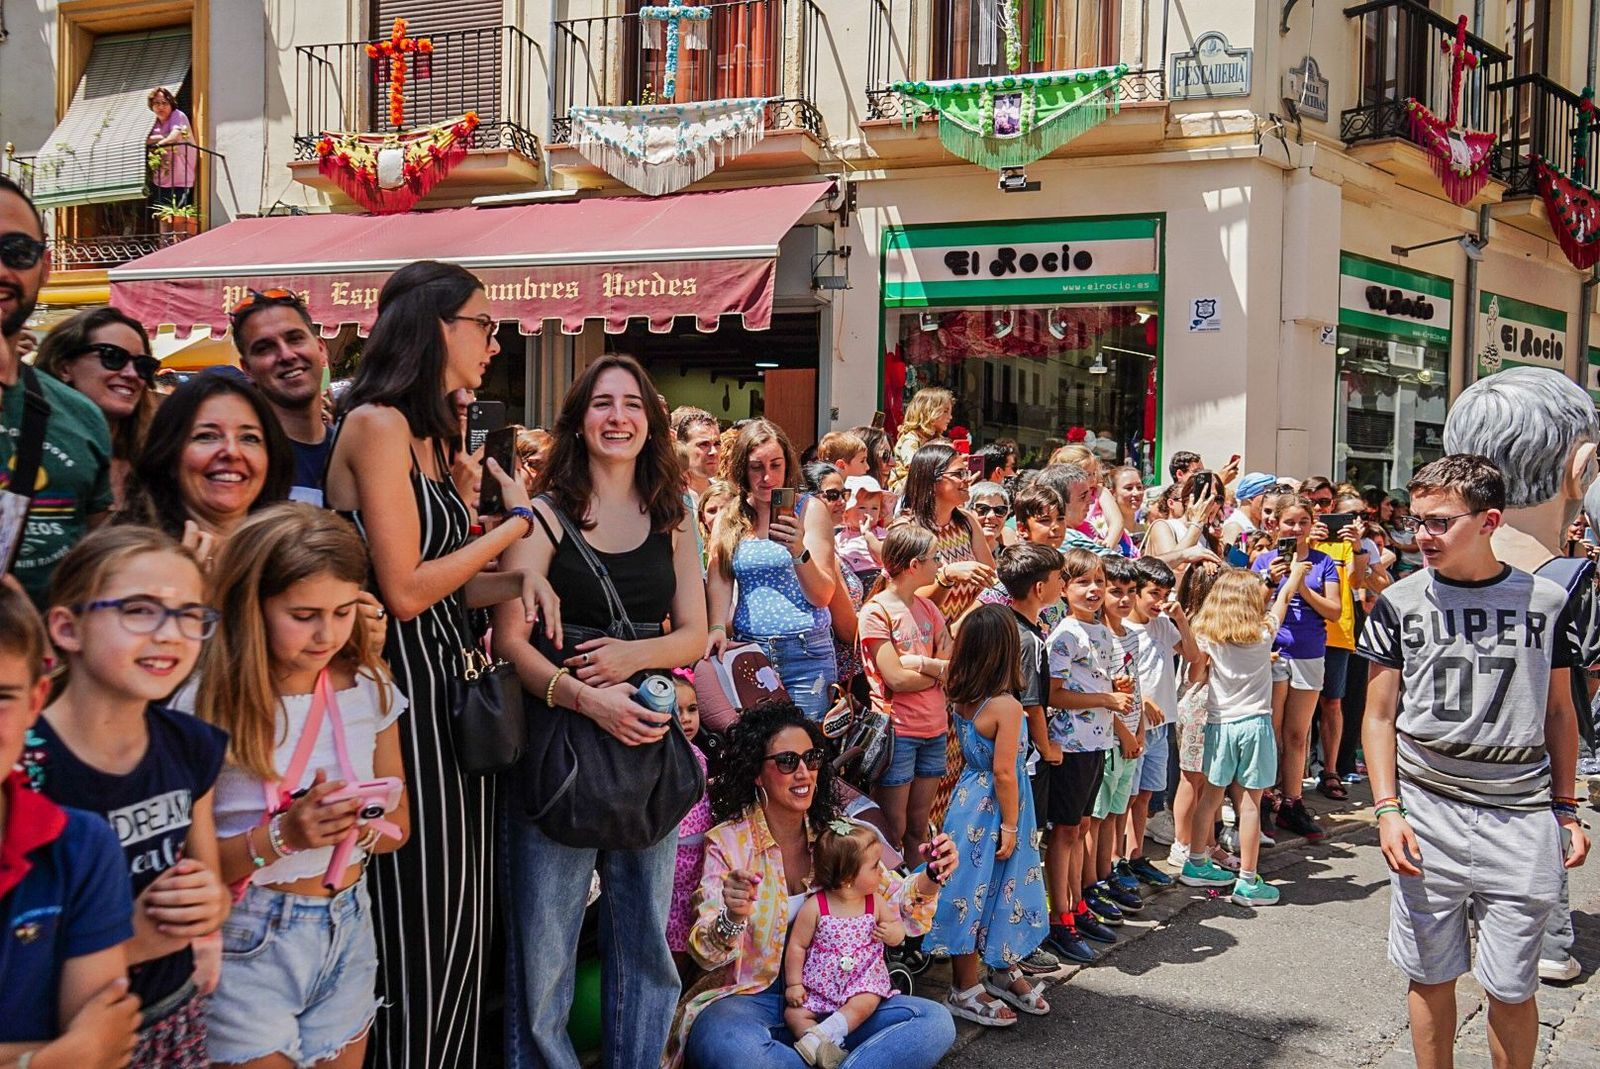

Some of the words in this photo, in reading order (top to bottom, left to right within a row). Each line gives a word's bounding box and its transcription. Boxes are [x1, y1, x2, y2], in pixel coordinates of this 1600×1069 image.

[1176, 62, 1244, 87] PESCADERIA
[944, 251, 980, 275] El
[989, 244, 1092, 276] Rocio
[481, 276, 580, 301] umbres
[602, 271, 698, 298] Verdes
[1062, 281, 1150, 291] www.elrocio.es
[1501, 324, 1517, 352] El
[1520, 327, 1563, 361] Rocio
[1402, 608, 1547, 649] SUPER
[1431, 656, 1517, 723] 07
